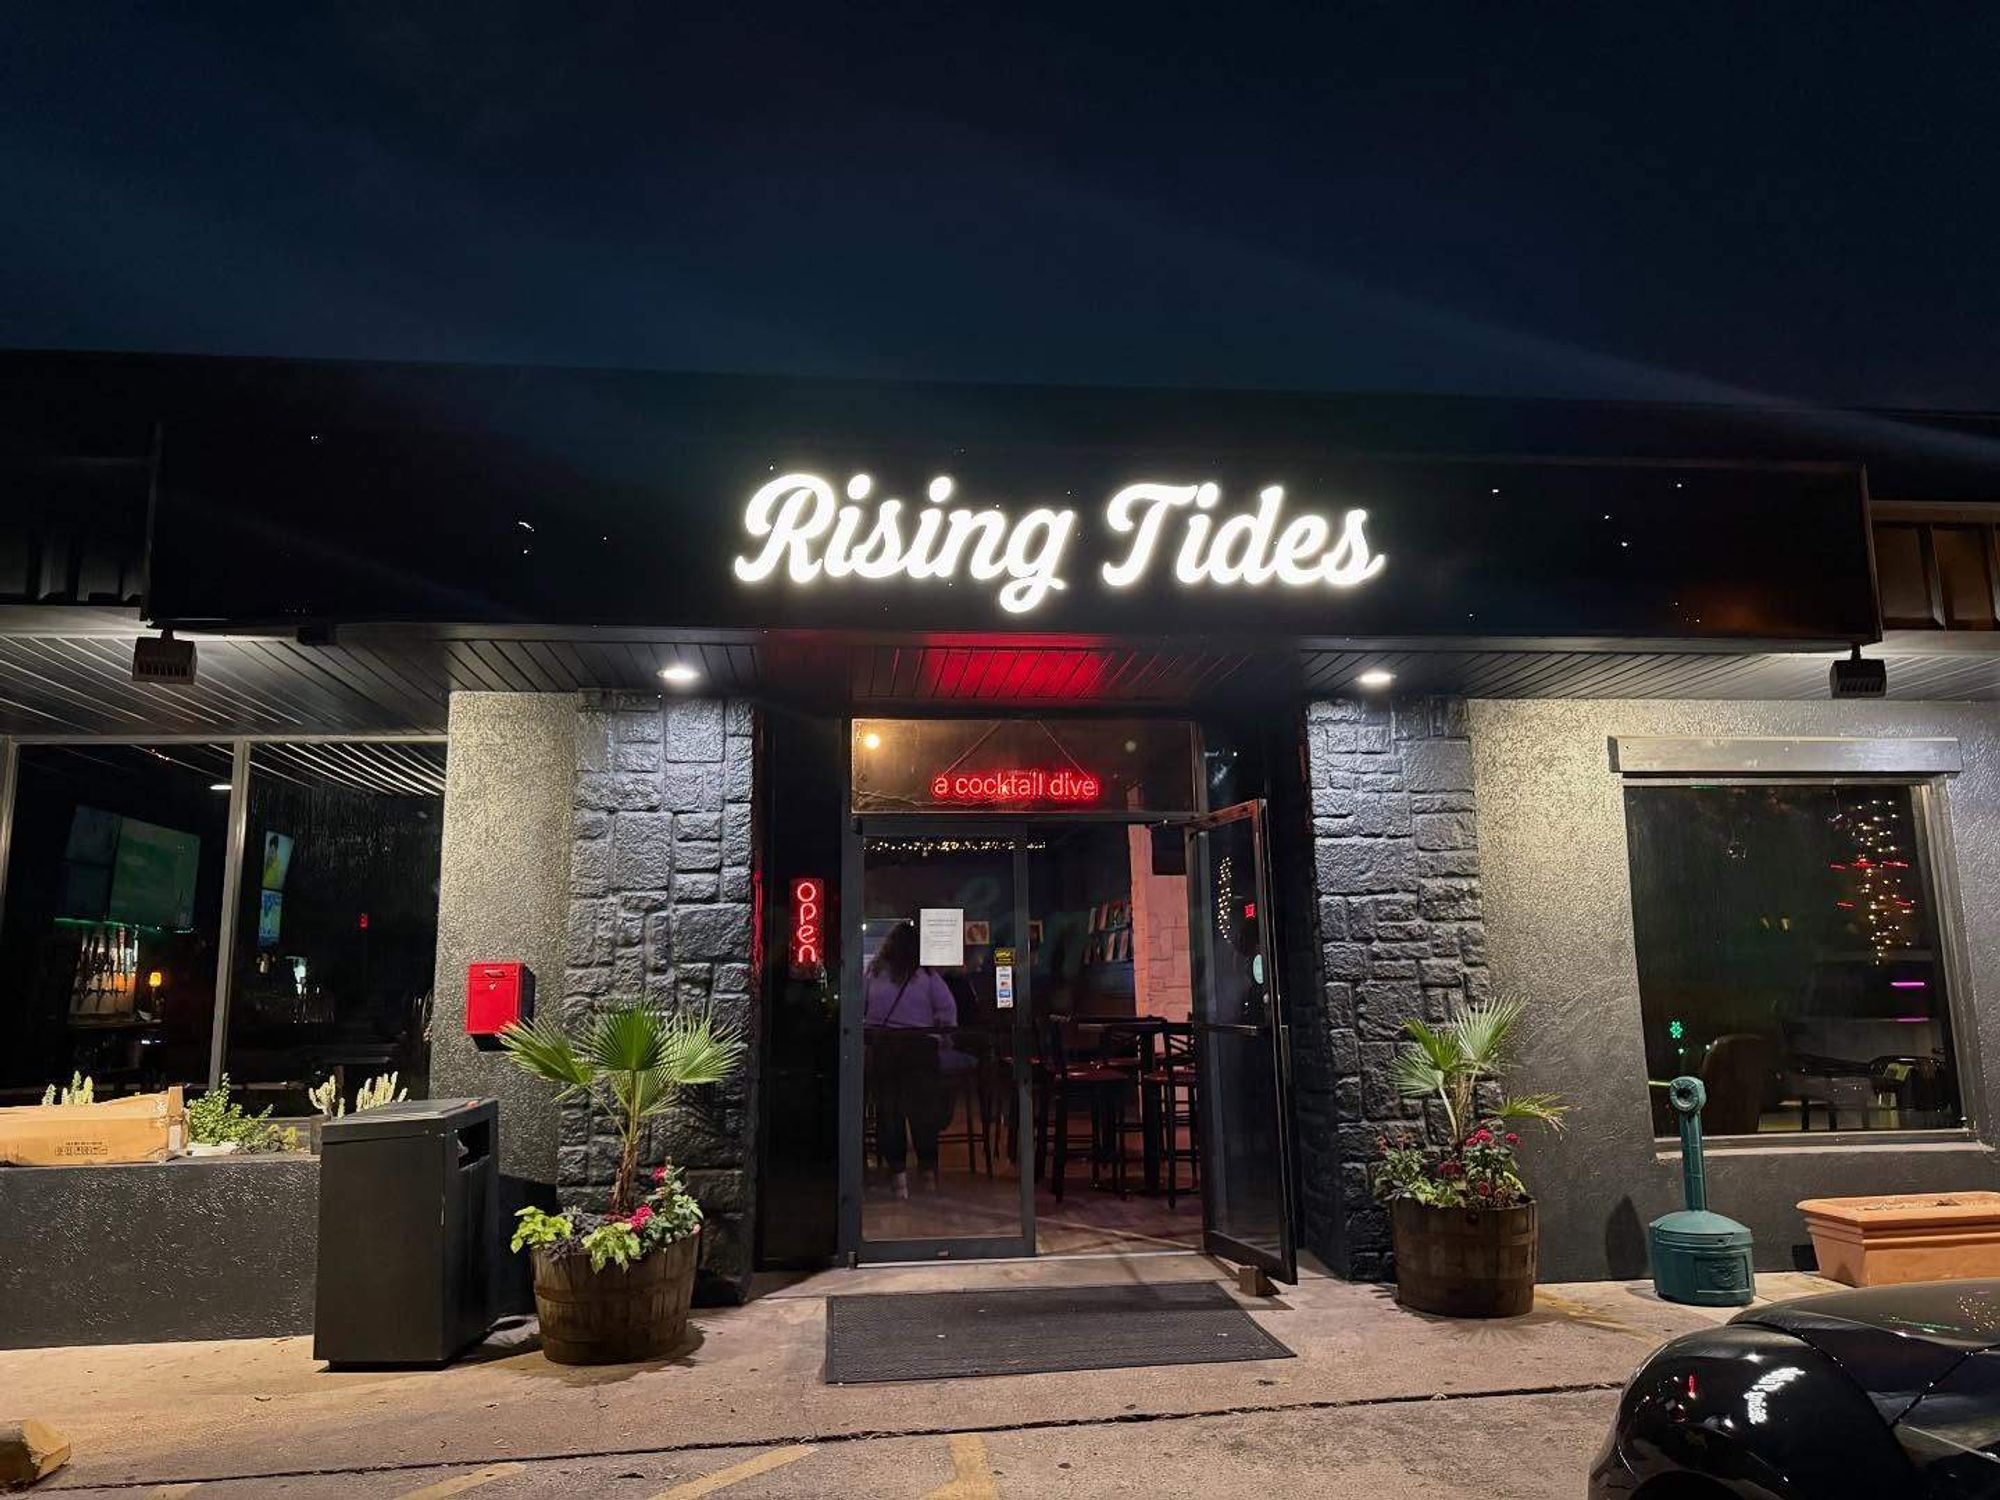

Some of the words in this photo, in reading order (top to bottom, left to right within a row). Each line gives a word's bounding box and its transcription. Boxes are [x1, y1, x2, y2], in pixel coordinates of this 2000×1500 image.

[733, 472, 1075, 615] Rising
[1101, 481, 1386, 588] Tides
[934, 775, 949, 796] a
[955, 771, 1044, 797] cocktail
[1048, 771, 1097, 797] dive
[796, 881, 818, 964] open
